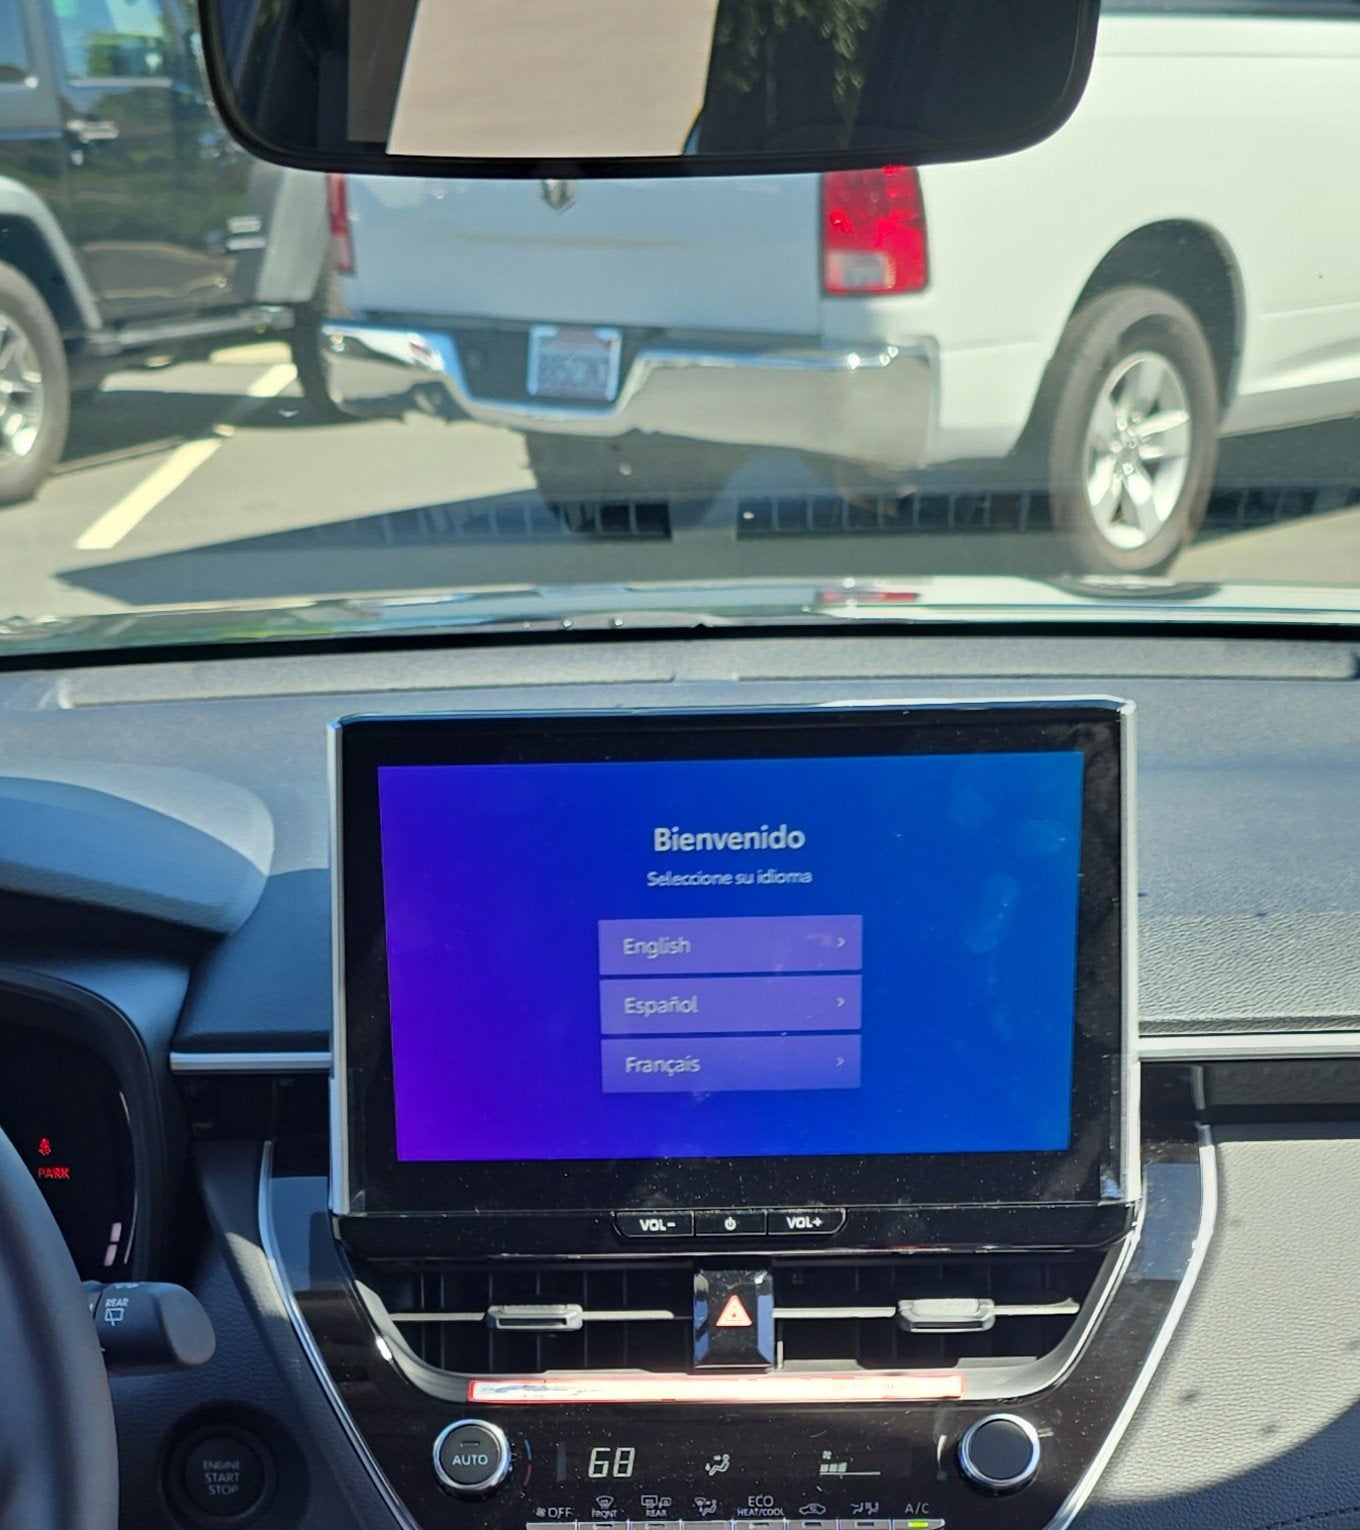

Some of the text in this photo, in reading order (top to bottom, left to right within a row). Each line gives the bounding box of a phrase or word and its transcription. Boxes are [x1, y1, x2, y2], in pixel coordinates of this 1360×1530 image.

[653, 824, 806, 851] Bienvenido
[646, 868, 813, 887] Seleccione su idioma
[622, 936, 692, 959] English
[624, 995, 699, 1018] Español
[624, 1055, 702, 1077] Français
[38, 1166, 70, 1179] PARK
[105, 1298, 129, 1308] REAR
[203, 1460, 240, 1470] ENGINE
[452, 1454, 488, 1466] AUTO
[588, 1447, 636, 1478] 68
[204, 1472, 240, 1483] START
[207, 1484, 240, 1496] STOP
[747, 1495, 775, 1508] ECO
[548, 1507, 572, 1519] OFF
[591, 1509, 618, 1518] FRONT
[645, 1509, 668, 1517] REAR
[737, 1507, 785, 1517] HEAT/COOL
[905, 1502, 931, 1515] A/C
